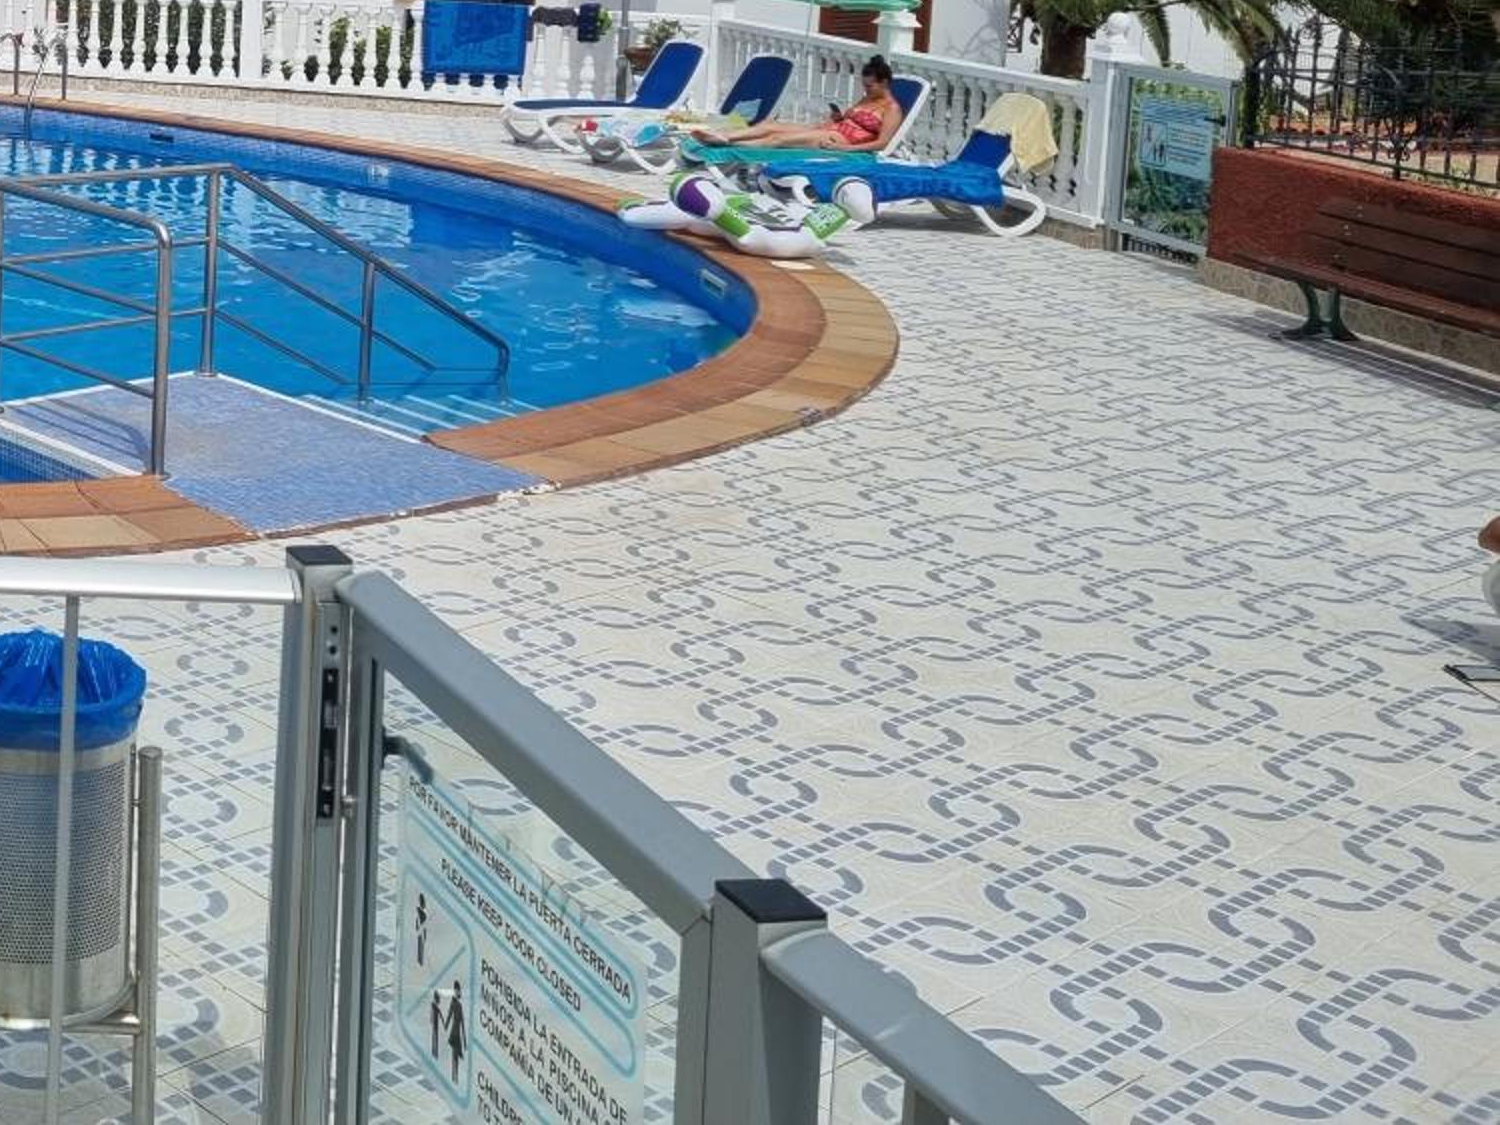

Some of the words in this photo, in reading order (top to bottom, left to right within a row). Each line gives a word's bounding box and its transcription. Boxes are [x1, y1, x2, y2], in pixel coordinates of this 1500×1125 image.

[459, 825, 513, 884] MANTENER
[513, 876, 528, 903] LA
[529, 891, 572, 946] PUERTA
[573, 935, 631, 1004] CERRADA
[504, 922, 536, 967] DOOR
[536, 956, 582, 1013] CLOSED
[530, 1037, 546, 1067] LA
[533, 1013, 549, 1046] LA
[550, 1032, 608, 1109] ENTRADA
[537, 1072, 554, 1106] DE
